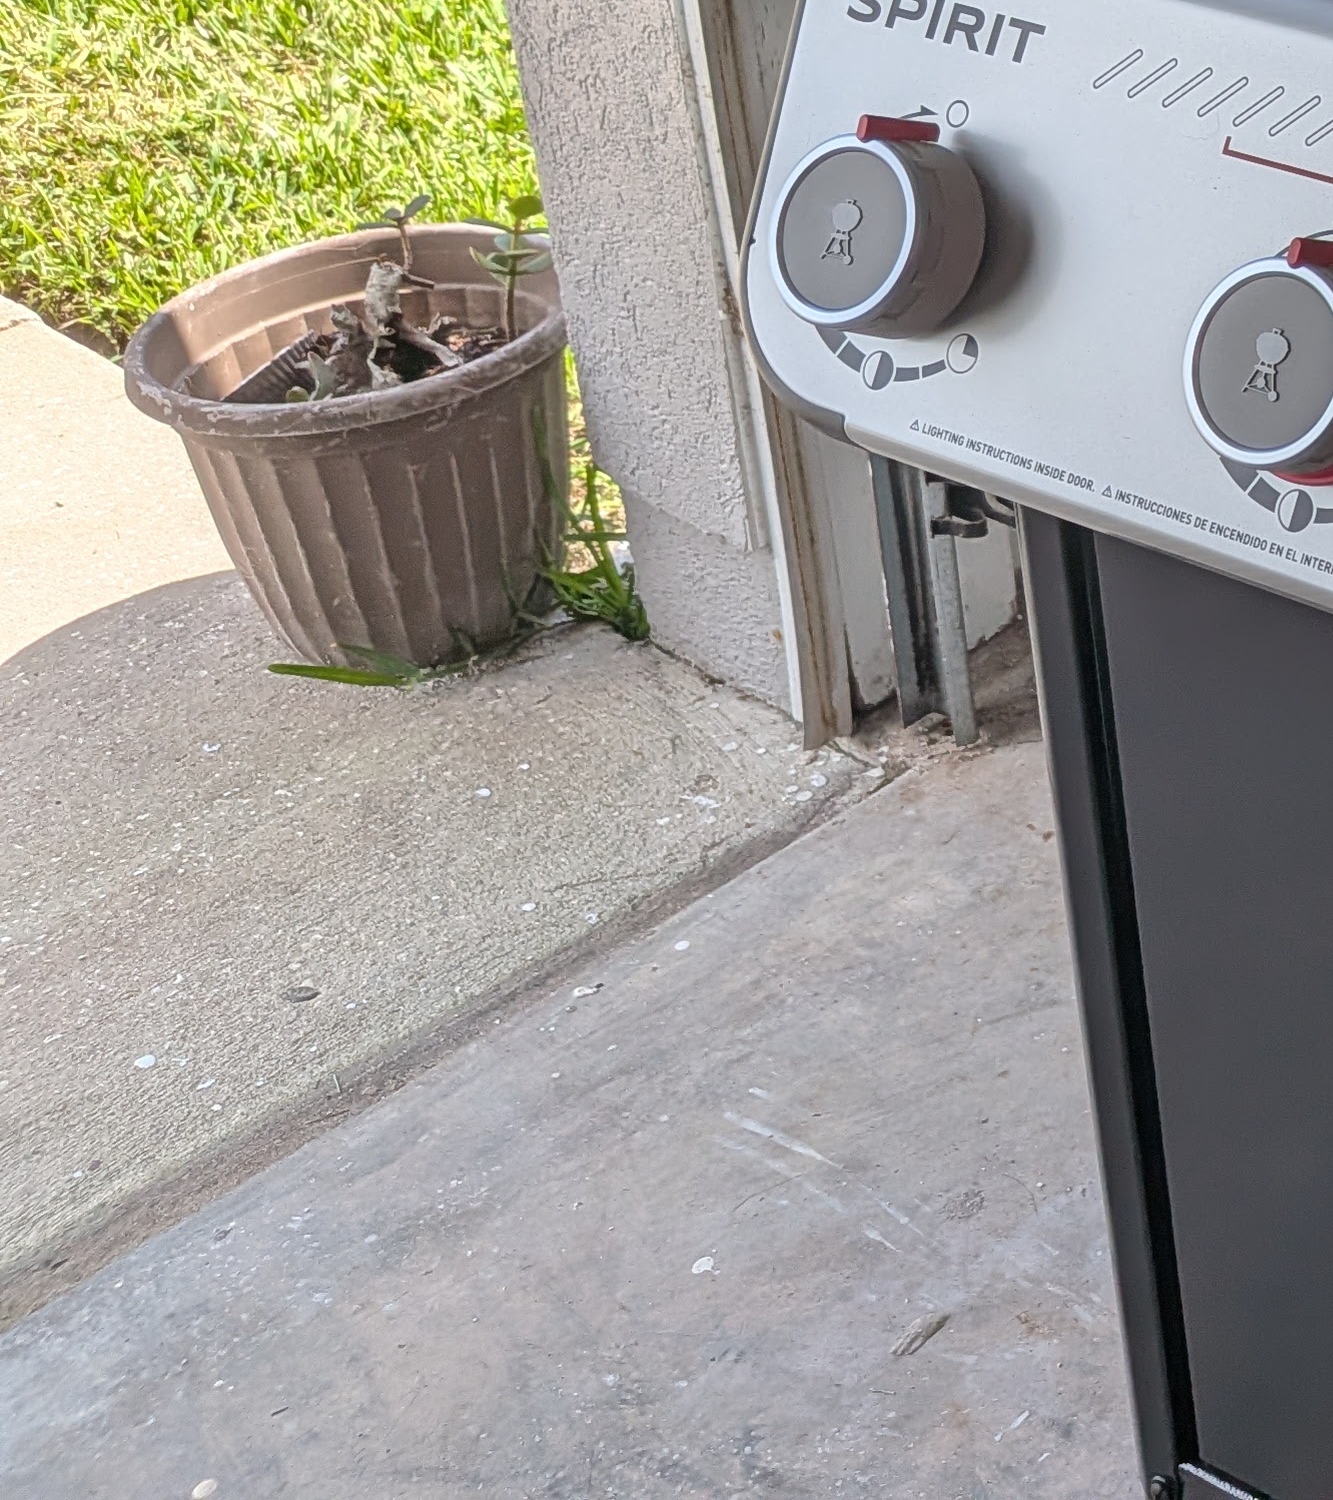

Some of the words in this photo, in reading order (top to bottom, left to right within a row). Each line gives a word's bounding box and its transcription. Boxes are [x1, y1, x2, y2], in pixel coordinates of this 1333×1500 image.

[922, 422, 965, 447] LIGHTING
[965, 437, 1033, 471] INSTRUCTIONS
[1034, 461, 1066, 483] INSIDE
[1067, 471, 1096, 493] DOOR.
[1114, 488, 1193, 526] INSTRUCCIONES
[1194, 514, 1209, 531] DE
[1209, 520, 1268, 552] ENCENDIDO
[1269, 541, 1285, 558] EN
[1285, 547, 1299, 563] EL
